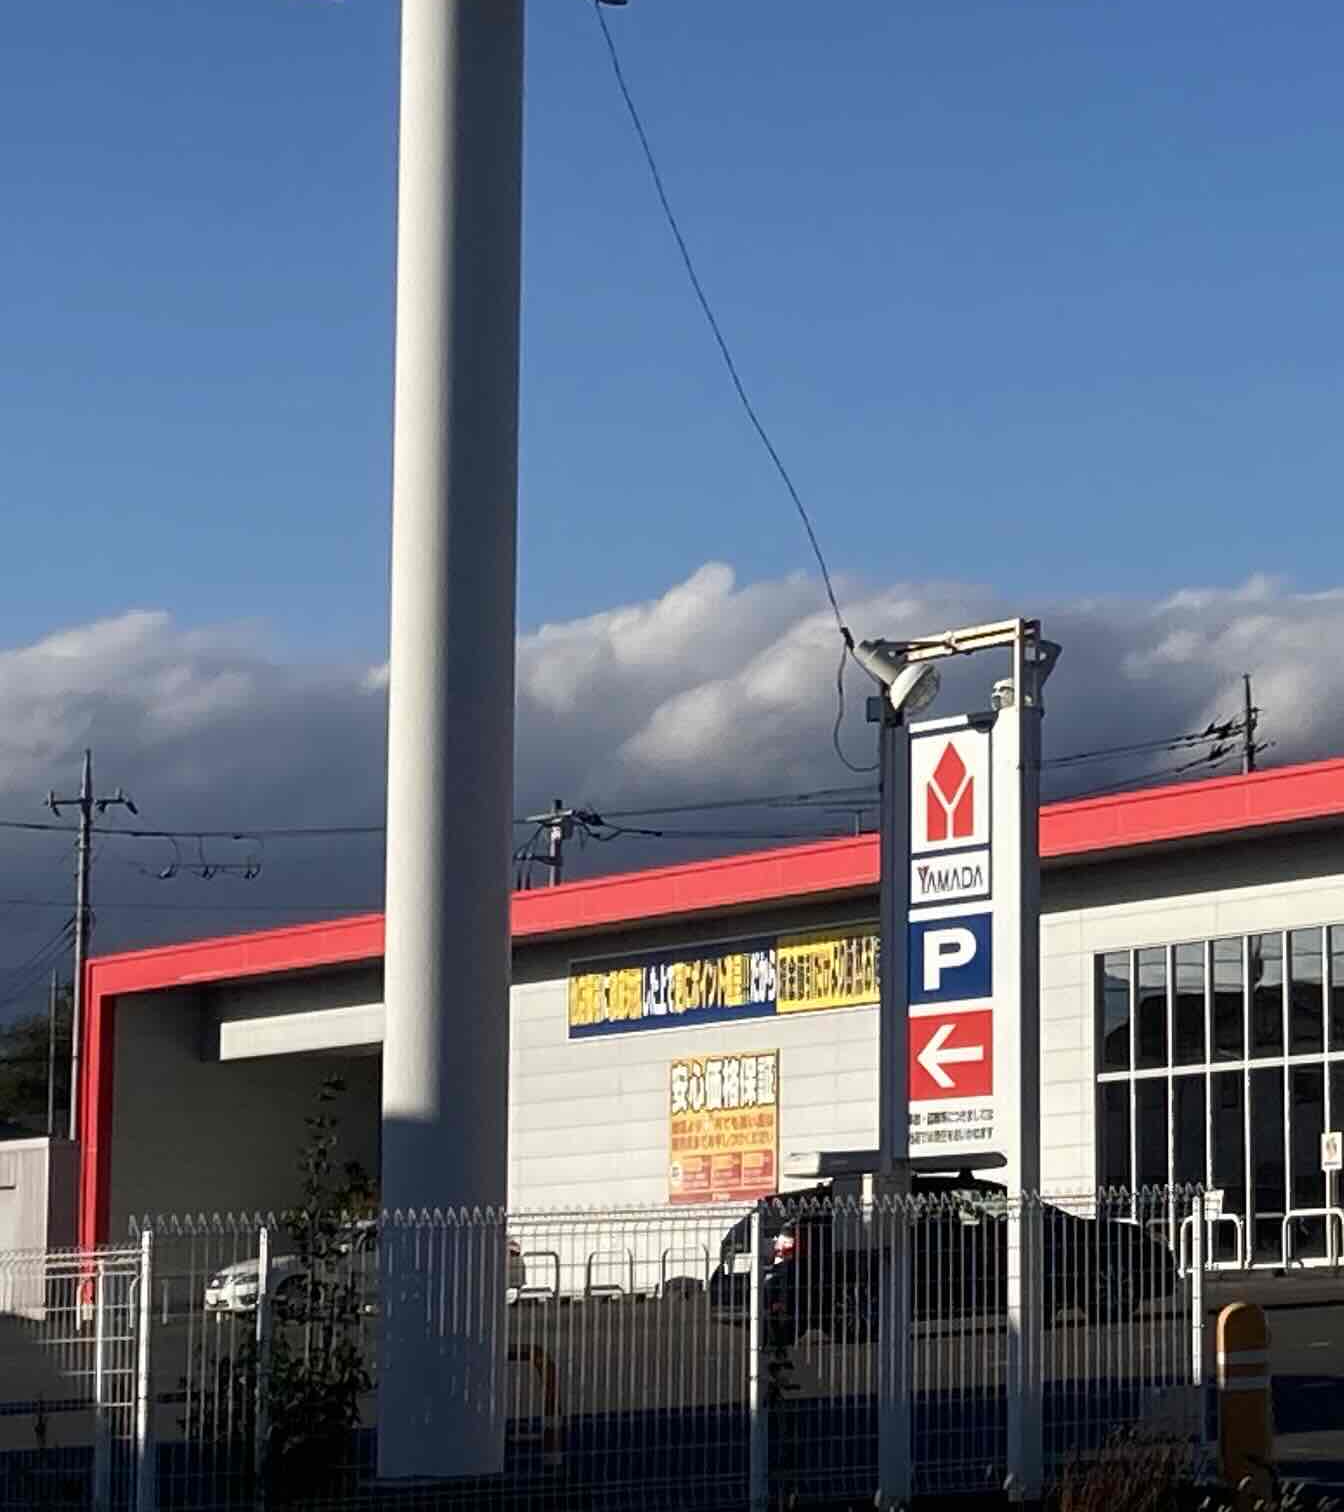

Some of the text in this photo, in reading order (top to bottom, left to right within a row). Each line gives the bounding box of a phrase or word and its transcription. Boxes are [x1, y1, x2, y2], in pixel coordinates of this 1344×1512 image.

[917, 865, 984, 894] YAMADA
[923, 927, 977, 992] P
[671, 1055, 777, 1115] 安心価格保証
